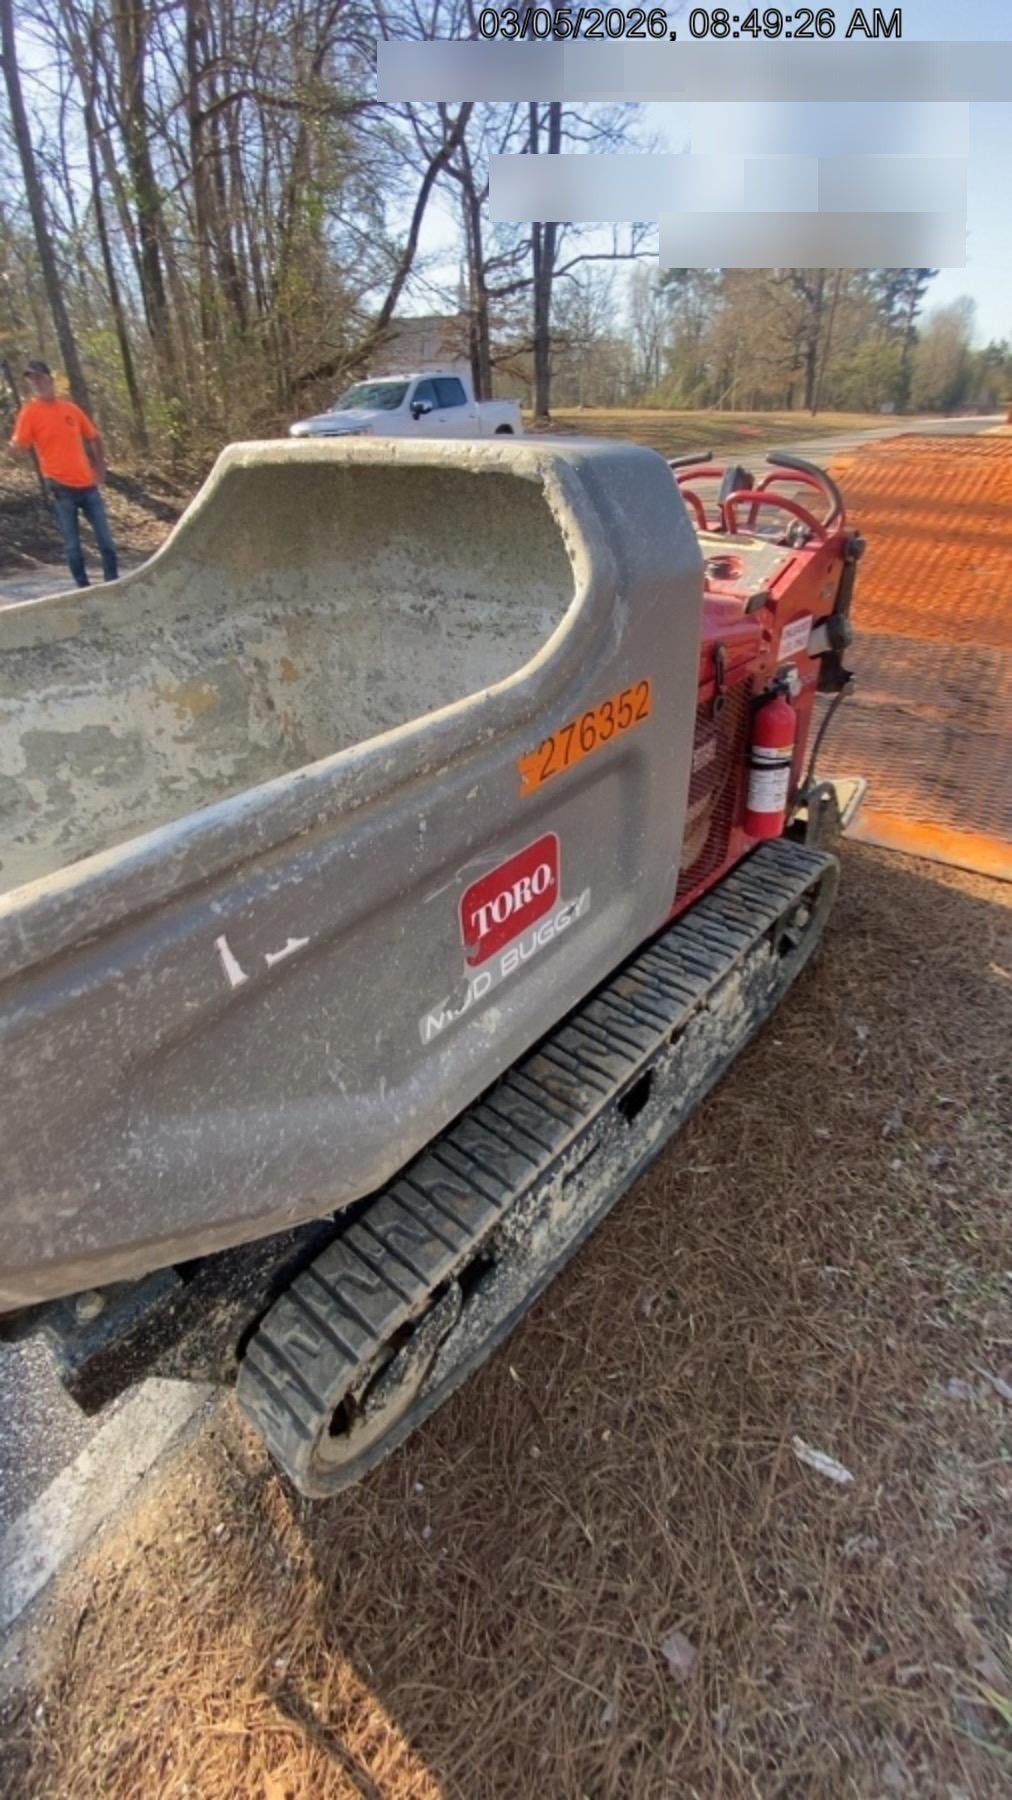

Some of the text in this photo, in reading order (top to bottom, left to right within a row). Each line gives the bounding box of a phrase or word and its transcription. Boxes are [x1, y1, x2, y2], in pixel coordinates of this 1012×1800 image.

[538, 680, 649, 782] 276352
[471, 864, 552, 939] TORO
[501, 889, 589, 977] BUGGY
